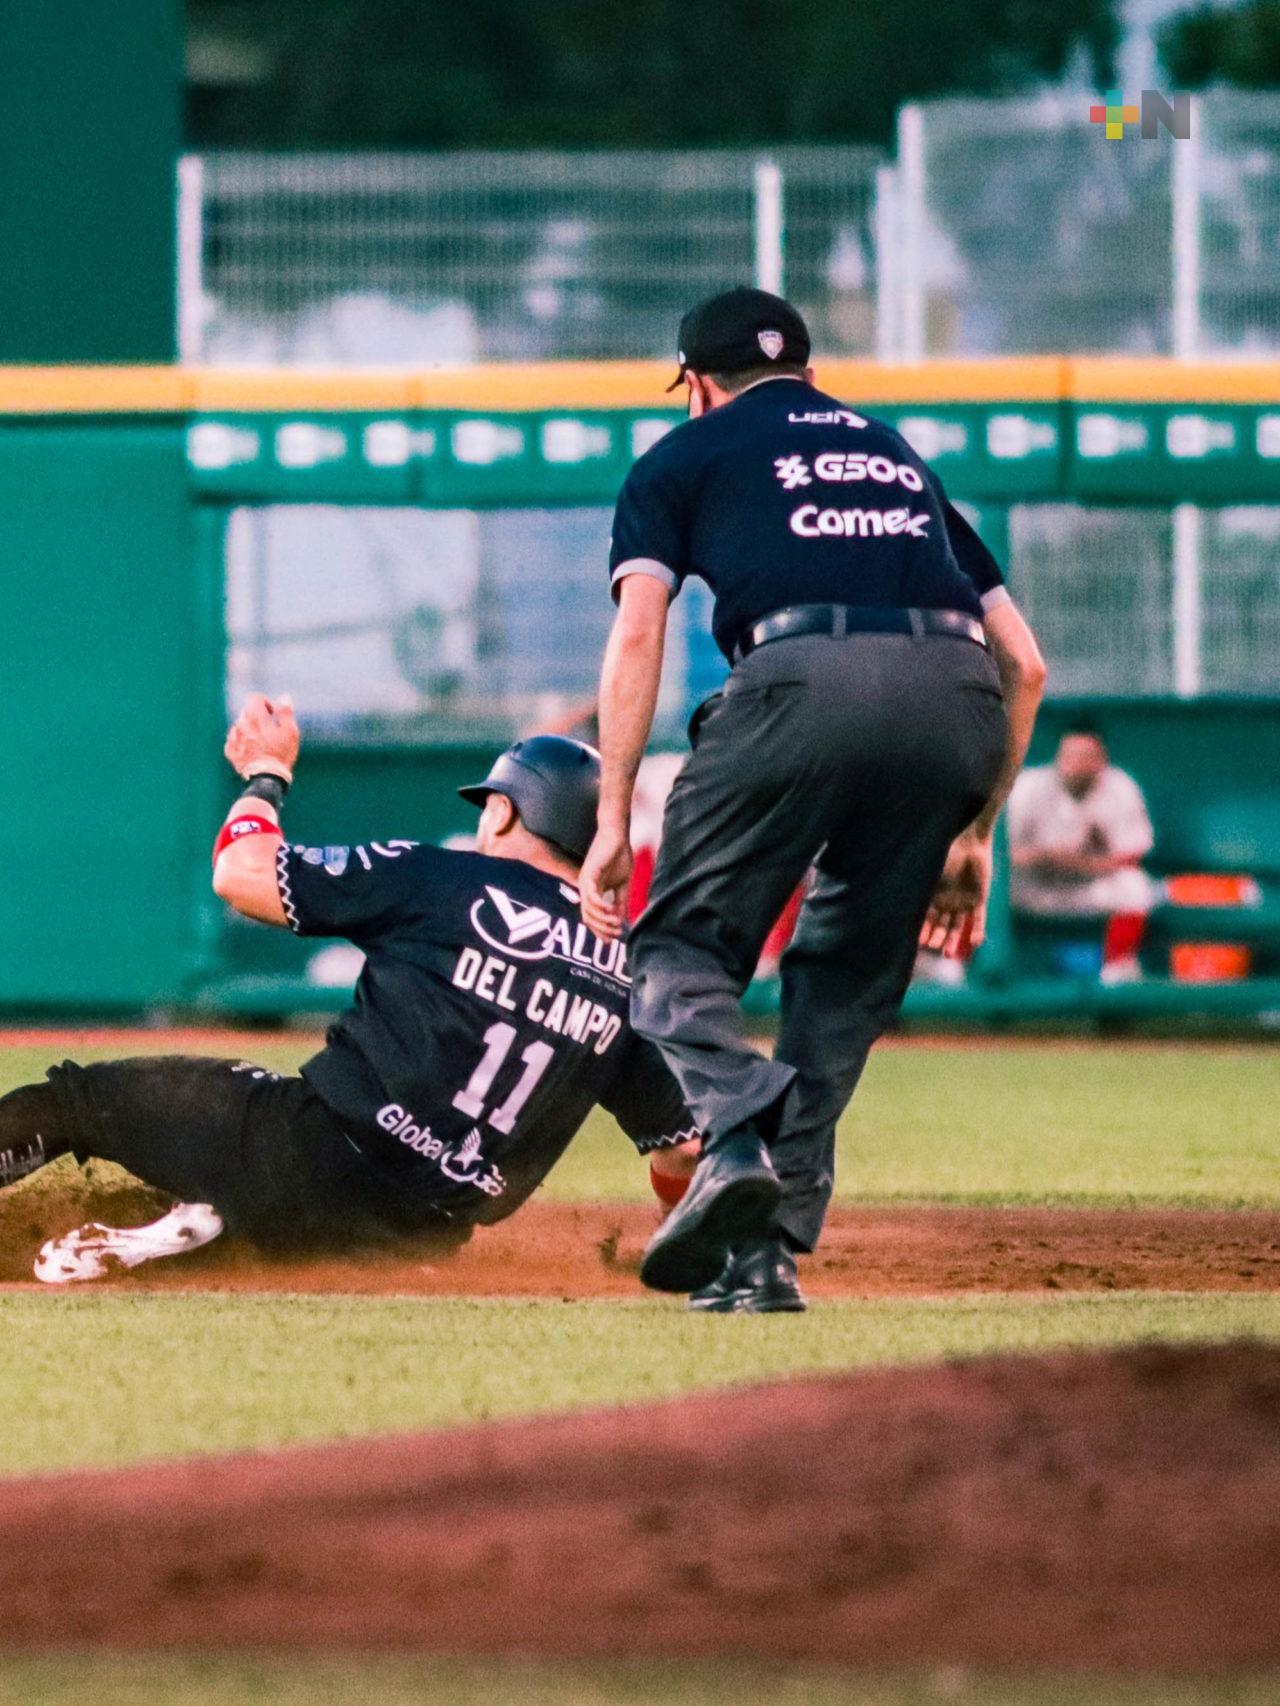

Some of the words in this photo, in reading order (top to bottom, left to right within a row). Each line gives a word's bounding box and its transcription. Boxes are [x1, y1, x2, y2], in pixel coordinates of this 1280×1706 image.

[814, 453, 923, 492] G500
[451, 947, 518, 1012] DEL
[525, 977, 622, 1056] CAMPO
[451, 1021, 554, 1136] 11
